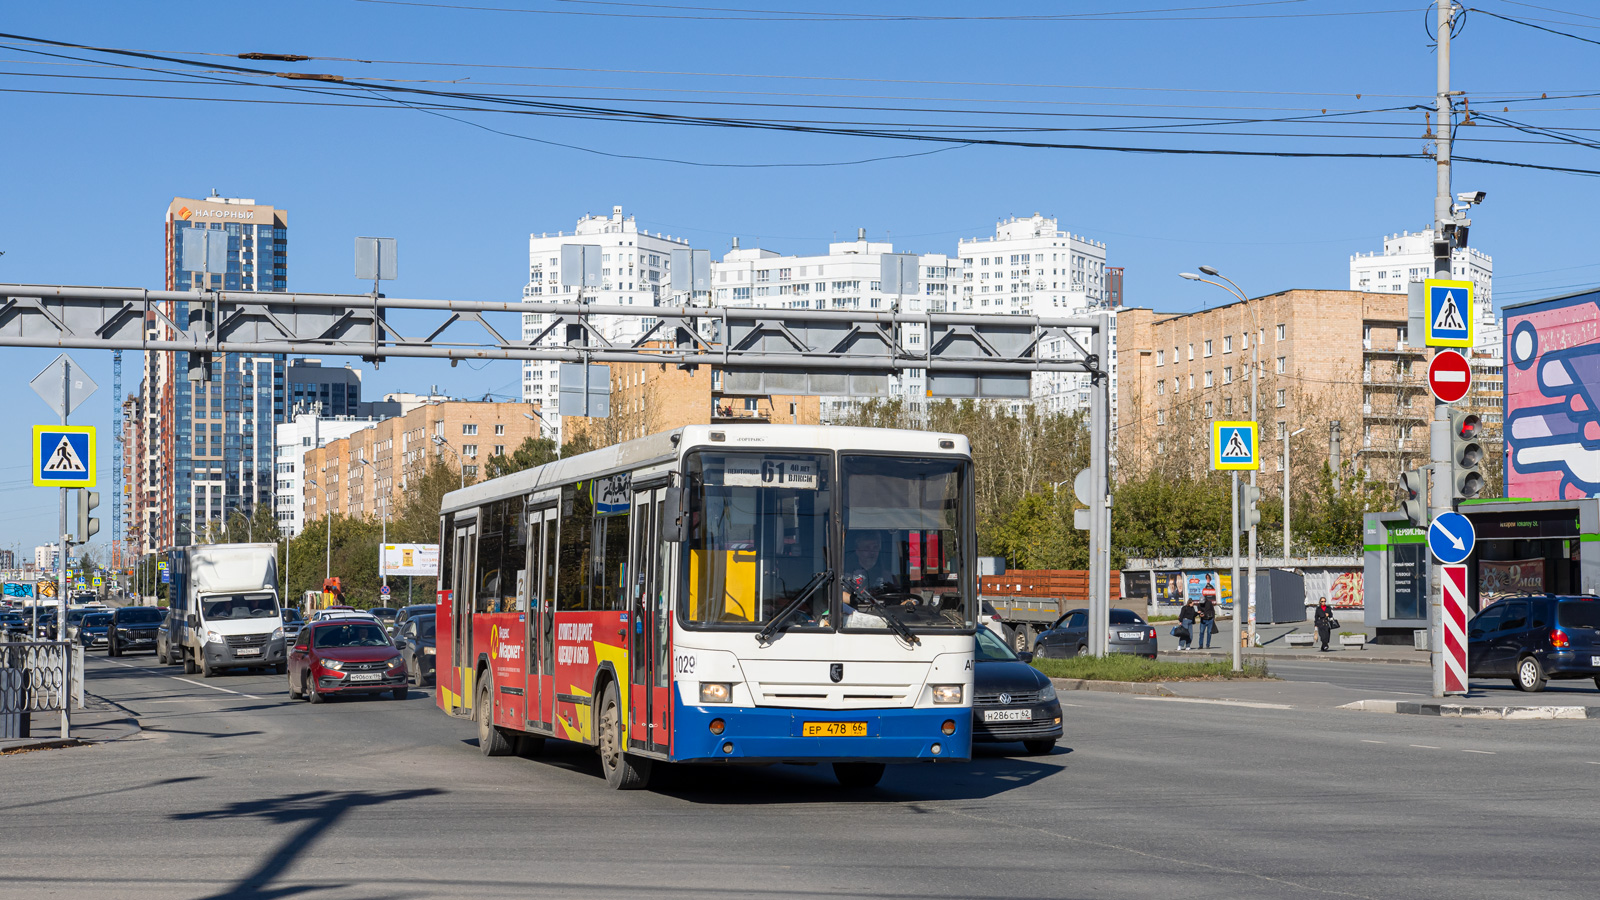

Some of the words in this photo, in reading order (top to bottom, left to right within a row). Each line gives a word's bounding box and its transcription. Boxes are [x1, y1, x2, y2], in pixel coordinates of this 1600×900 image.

[195, 209, 254, 219] НАГОРНЫЙ
[761, 460, 785, 483] 61
[790, 463, 799, 472] 40
[788, 474, 813, 483] ВЛКСМ
[1509, 565, 1521, 585] 9
[1518, 577, 1542, 587] мая
[499, 626, 510, 640] Яндекс
[558, 623, 572, 641] КУПИТЕ
[577, 623, 593, 643] ДОРОГЕ
[498, 642, 521, 661] Маркет
[558, 645, 573, 666] ОДЕЖДУ
[577, 646, 590, 664] ОБУВЬ
[675, 655, 695, 674] 1029
[987, 711, 1019, 720] Н286СТ
[809, 725, 822, 735] ЕР
[827, 723, 847, 735] 478
[852, 722, 863, 732] 66
